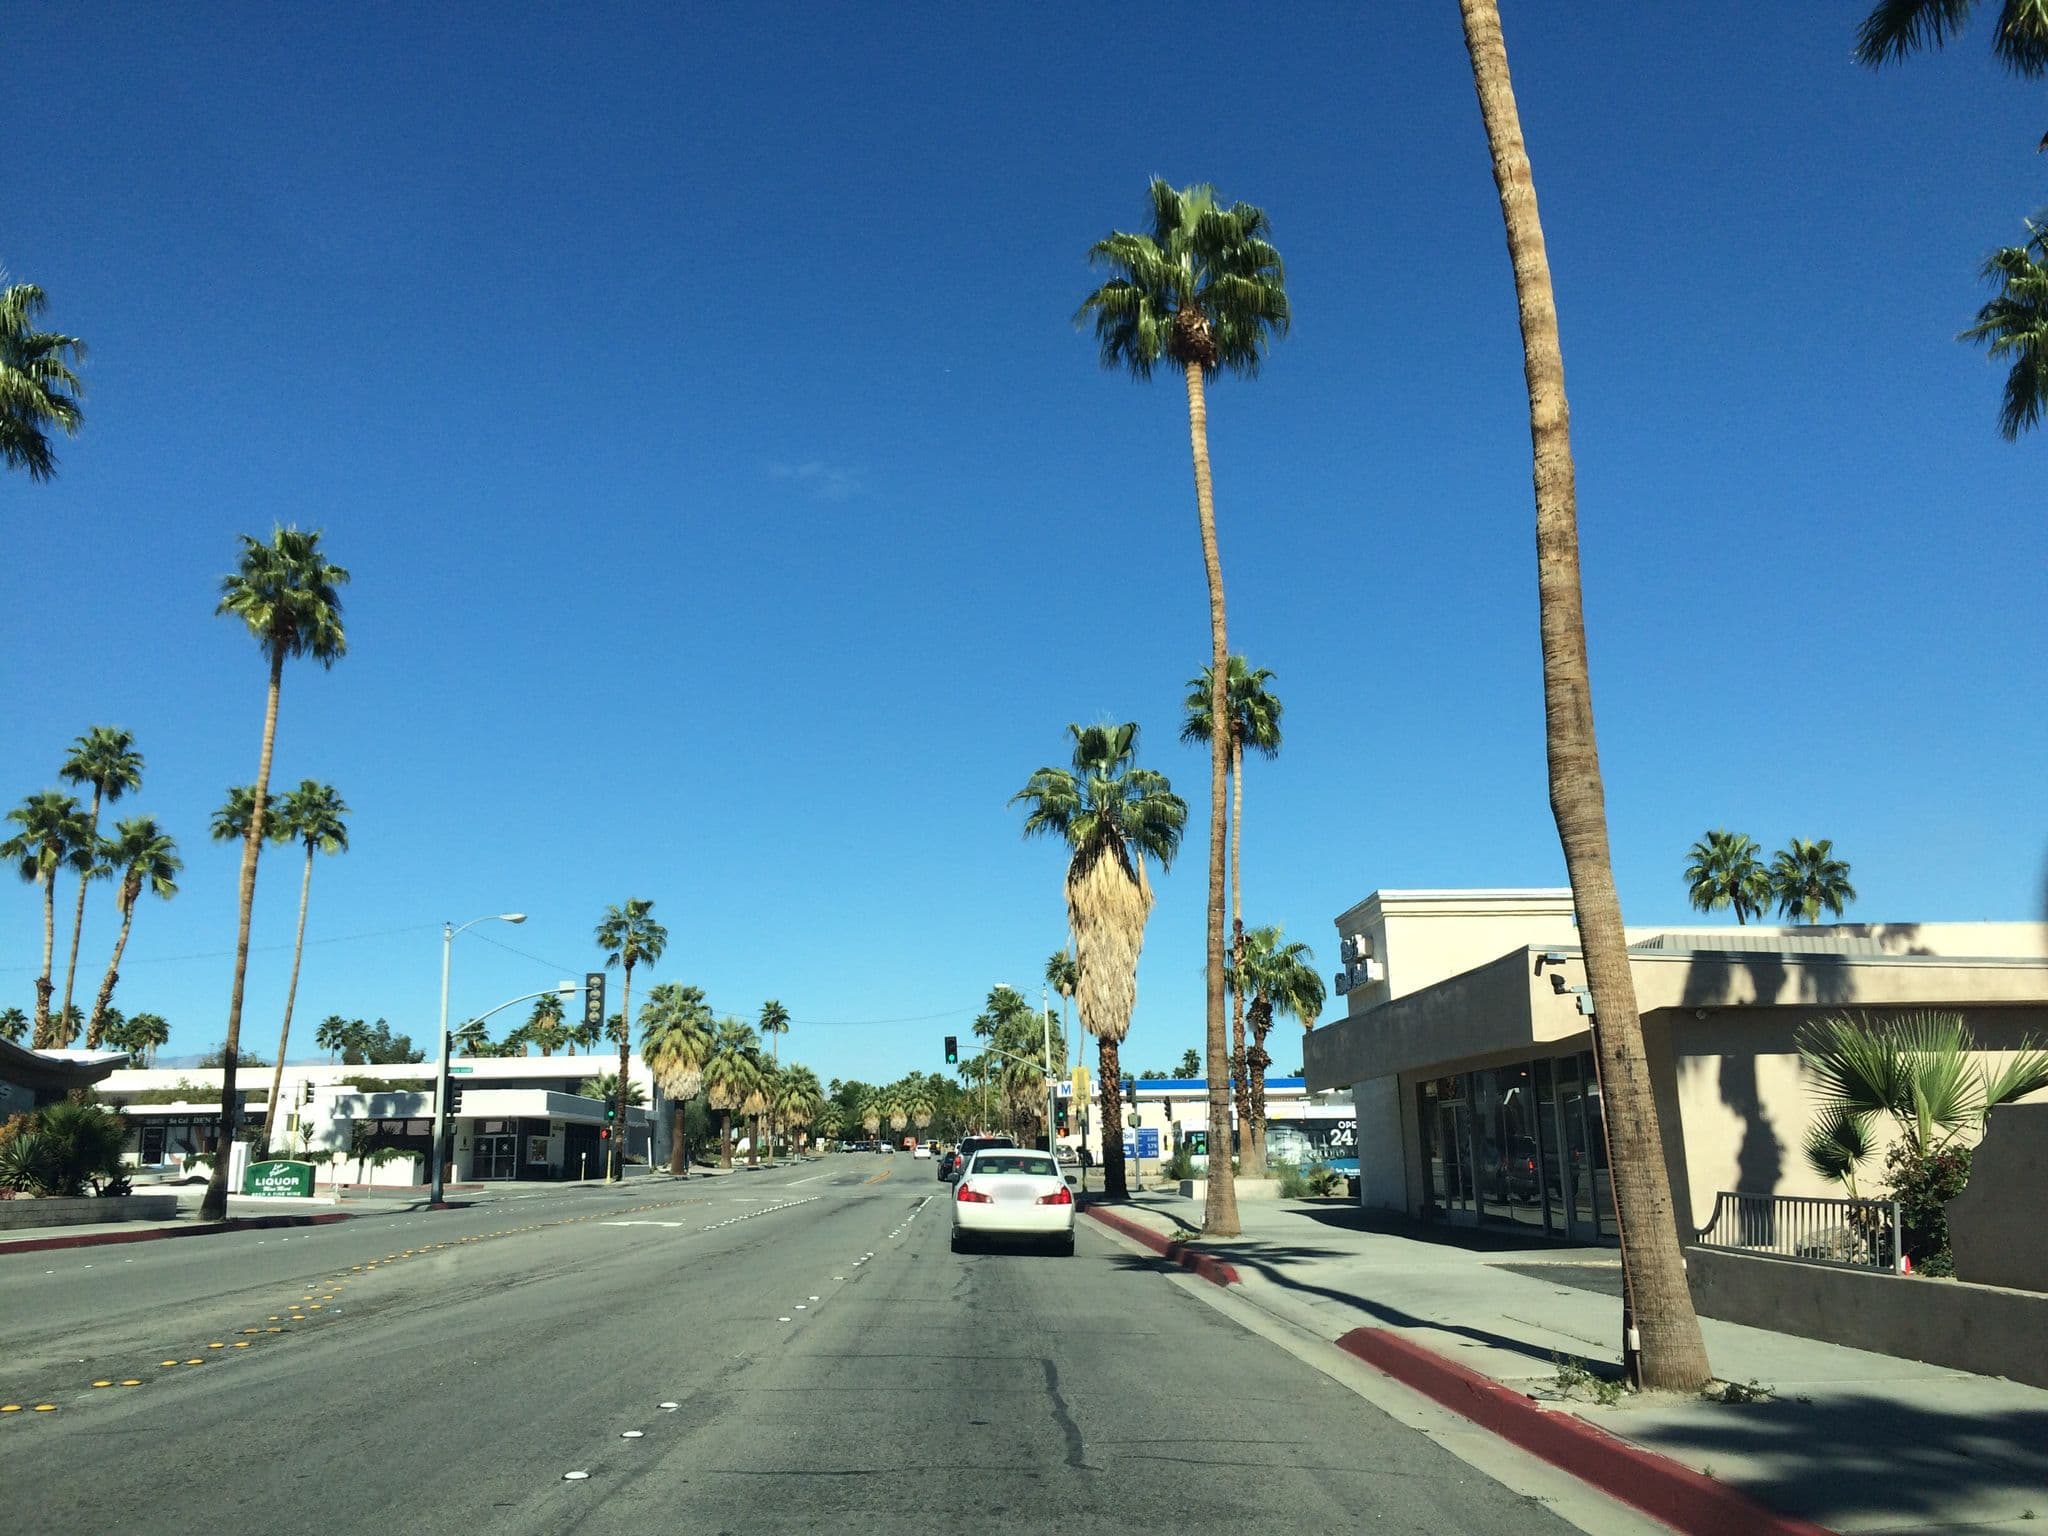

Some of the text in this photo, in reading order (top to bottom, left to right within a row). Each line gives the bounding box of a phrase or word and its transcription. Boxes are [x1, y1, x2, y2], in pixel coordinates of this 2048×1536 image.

[1338, 1121, 1358, 1129] OPE
[1330, 1128, 1358, 1146] 24/
[255, 1177, 299, 1186] LIQUOR
